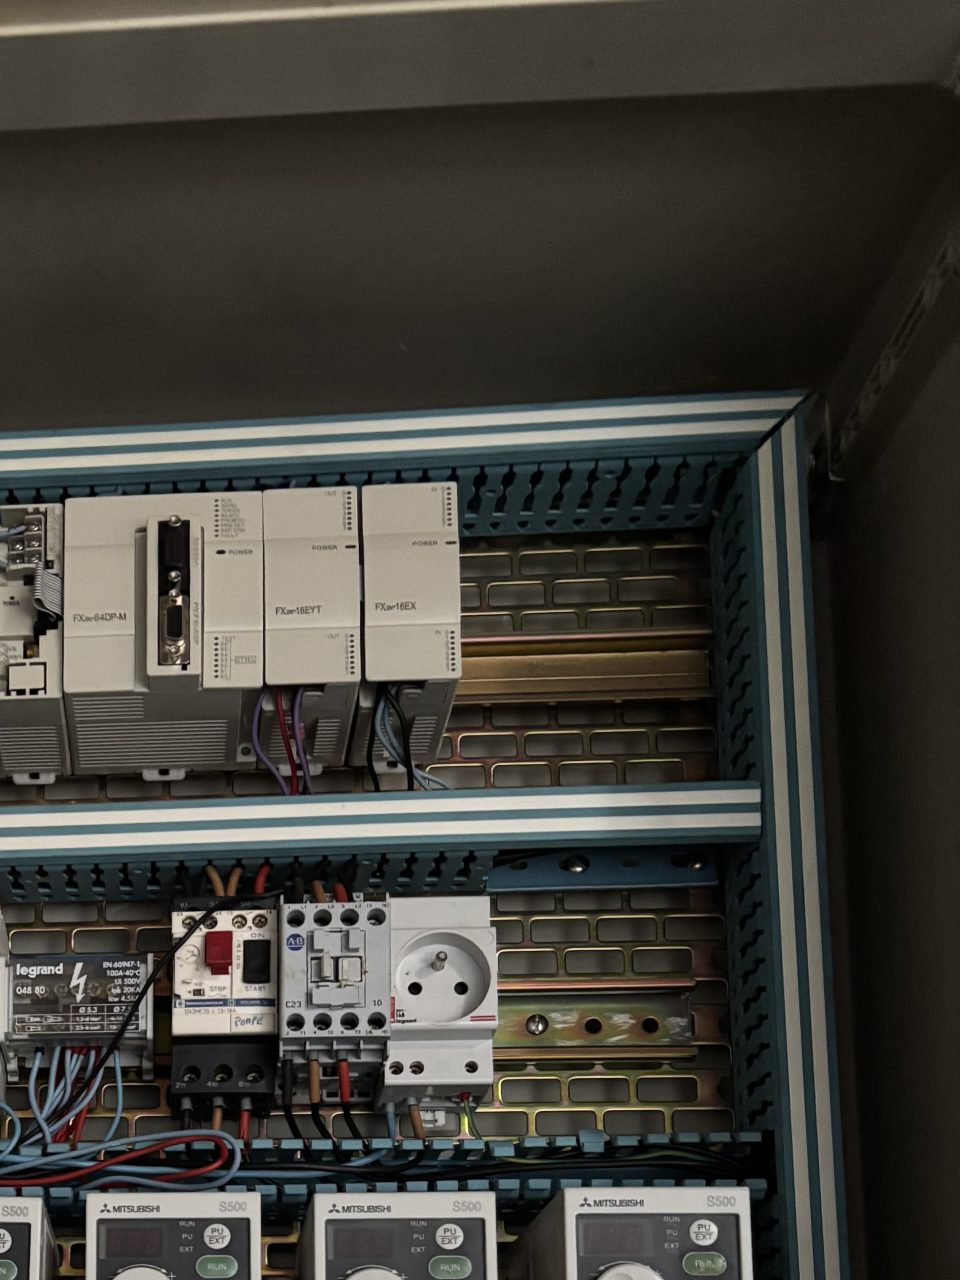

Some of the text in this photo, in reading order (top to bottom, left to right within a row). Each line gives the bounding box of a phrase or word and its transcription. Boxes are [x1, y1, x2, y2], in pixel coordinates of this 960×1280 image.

[16, 963, 63, 978] legrand
[16, 986, 45, 994] 048 80
[219, 1201, 247, 1212] S500
[453, 1201, 481, 1212] S500
[707, 1196, 736, 1207] S500
[1, 1206, 29, 1217] S500
[113, 1205, 160, 1213] MITSUBISHI
[695, 1233, 712, 1241] EXT
